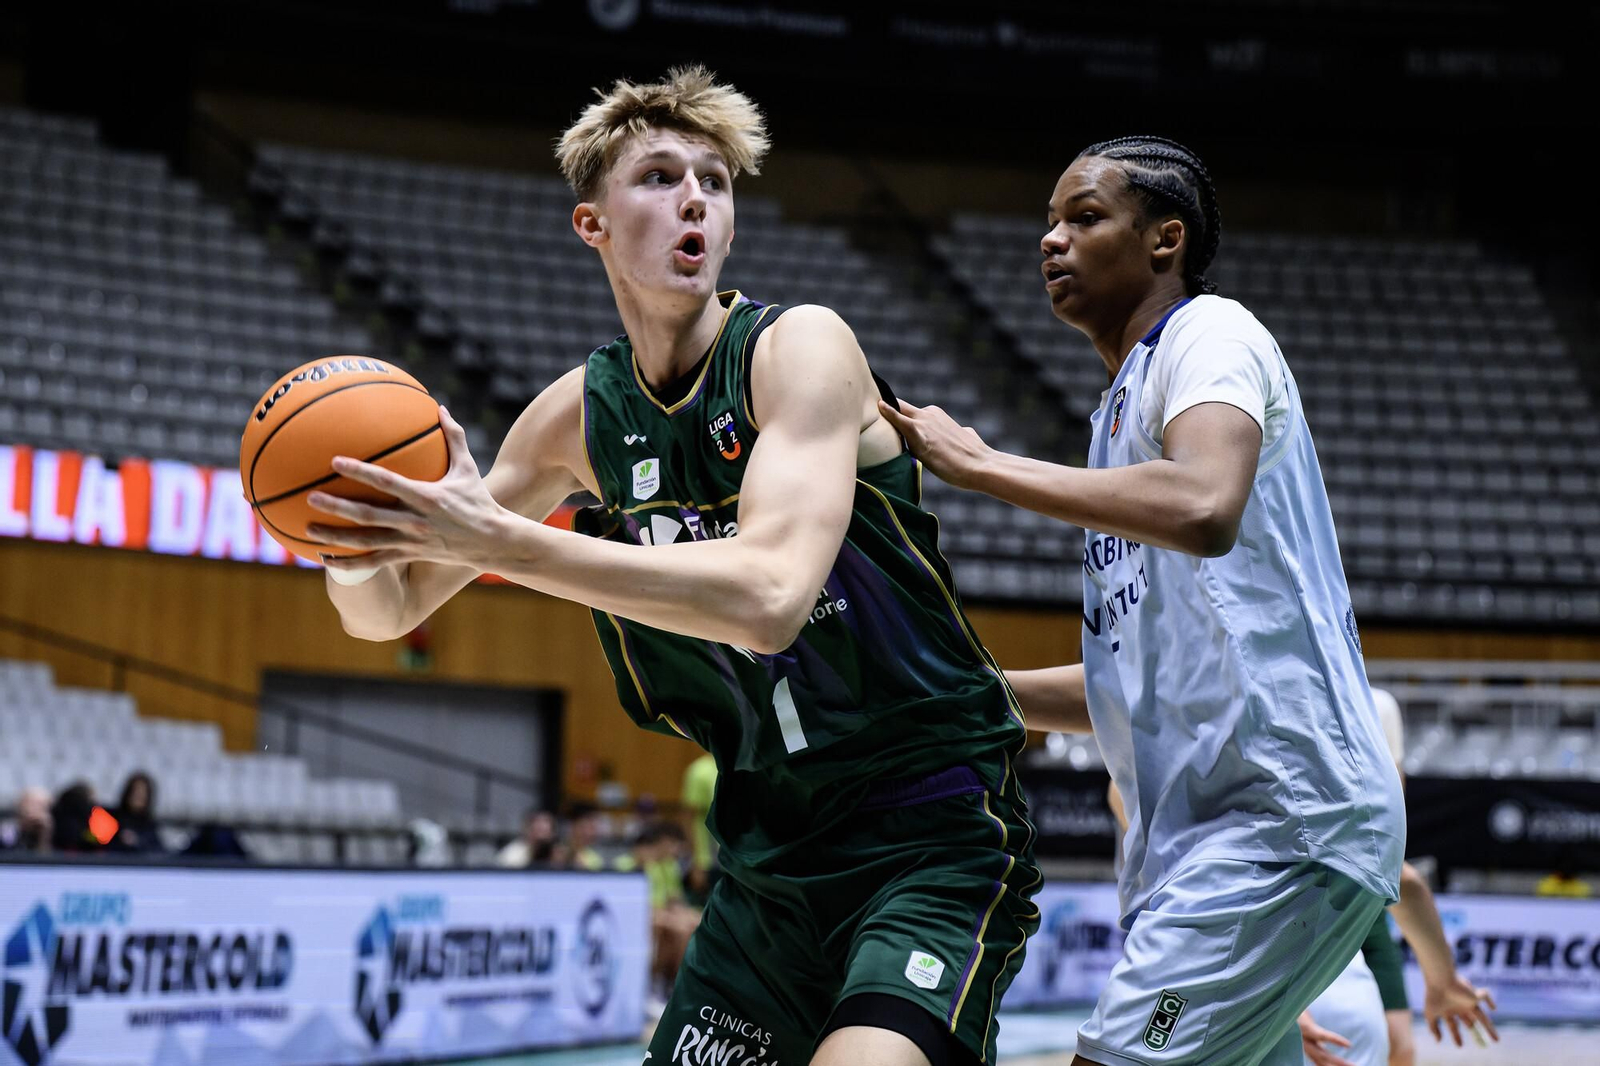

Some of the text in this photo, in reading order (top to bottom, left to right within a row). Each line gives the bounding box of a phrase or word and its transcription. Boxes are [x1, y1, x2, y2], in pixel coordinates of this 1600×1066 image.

[709, 411, 734, 436] LIGA
[772, 676, 809, 754] 1
[51, 929, 293, 998] MASTERCOLD
[699, 1005, 773, 1046] CLINICAS
